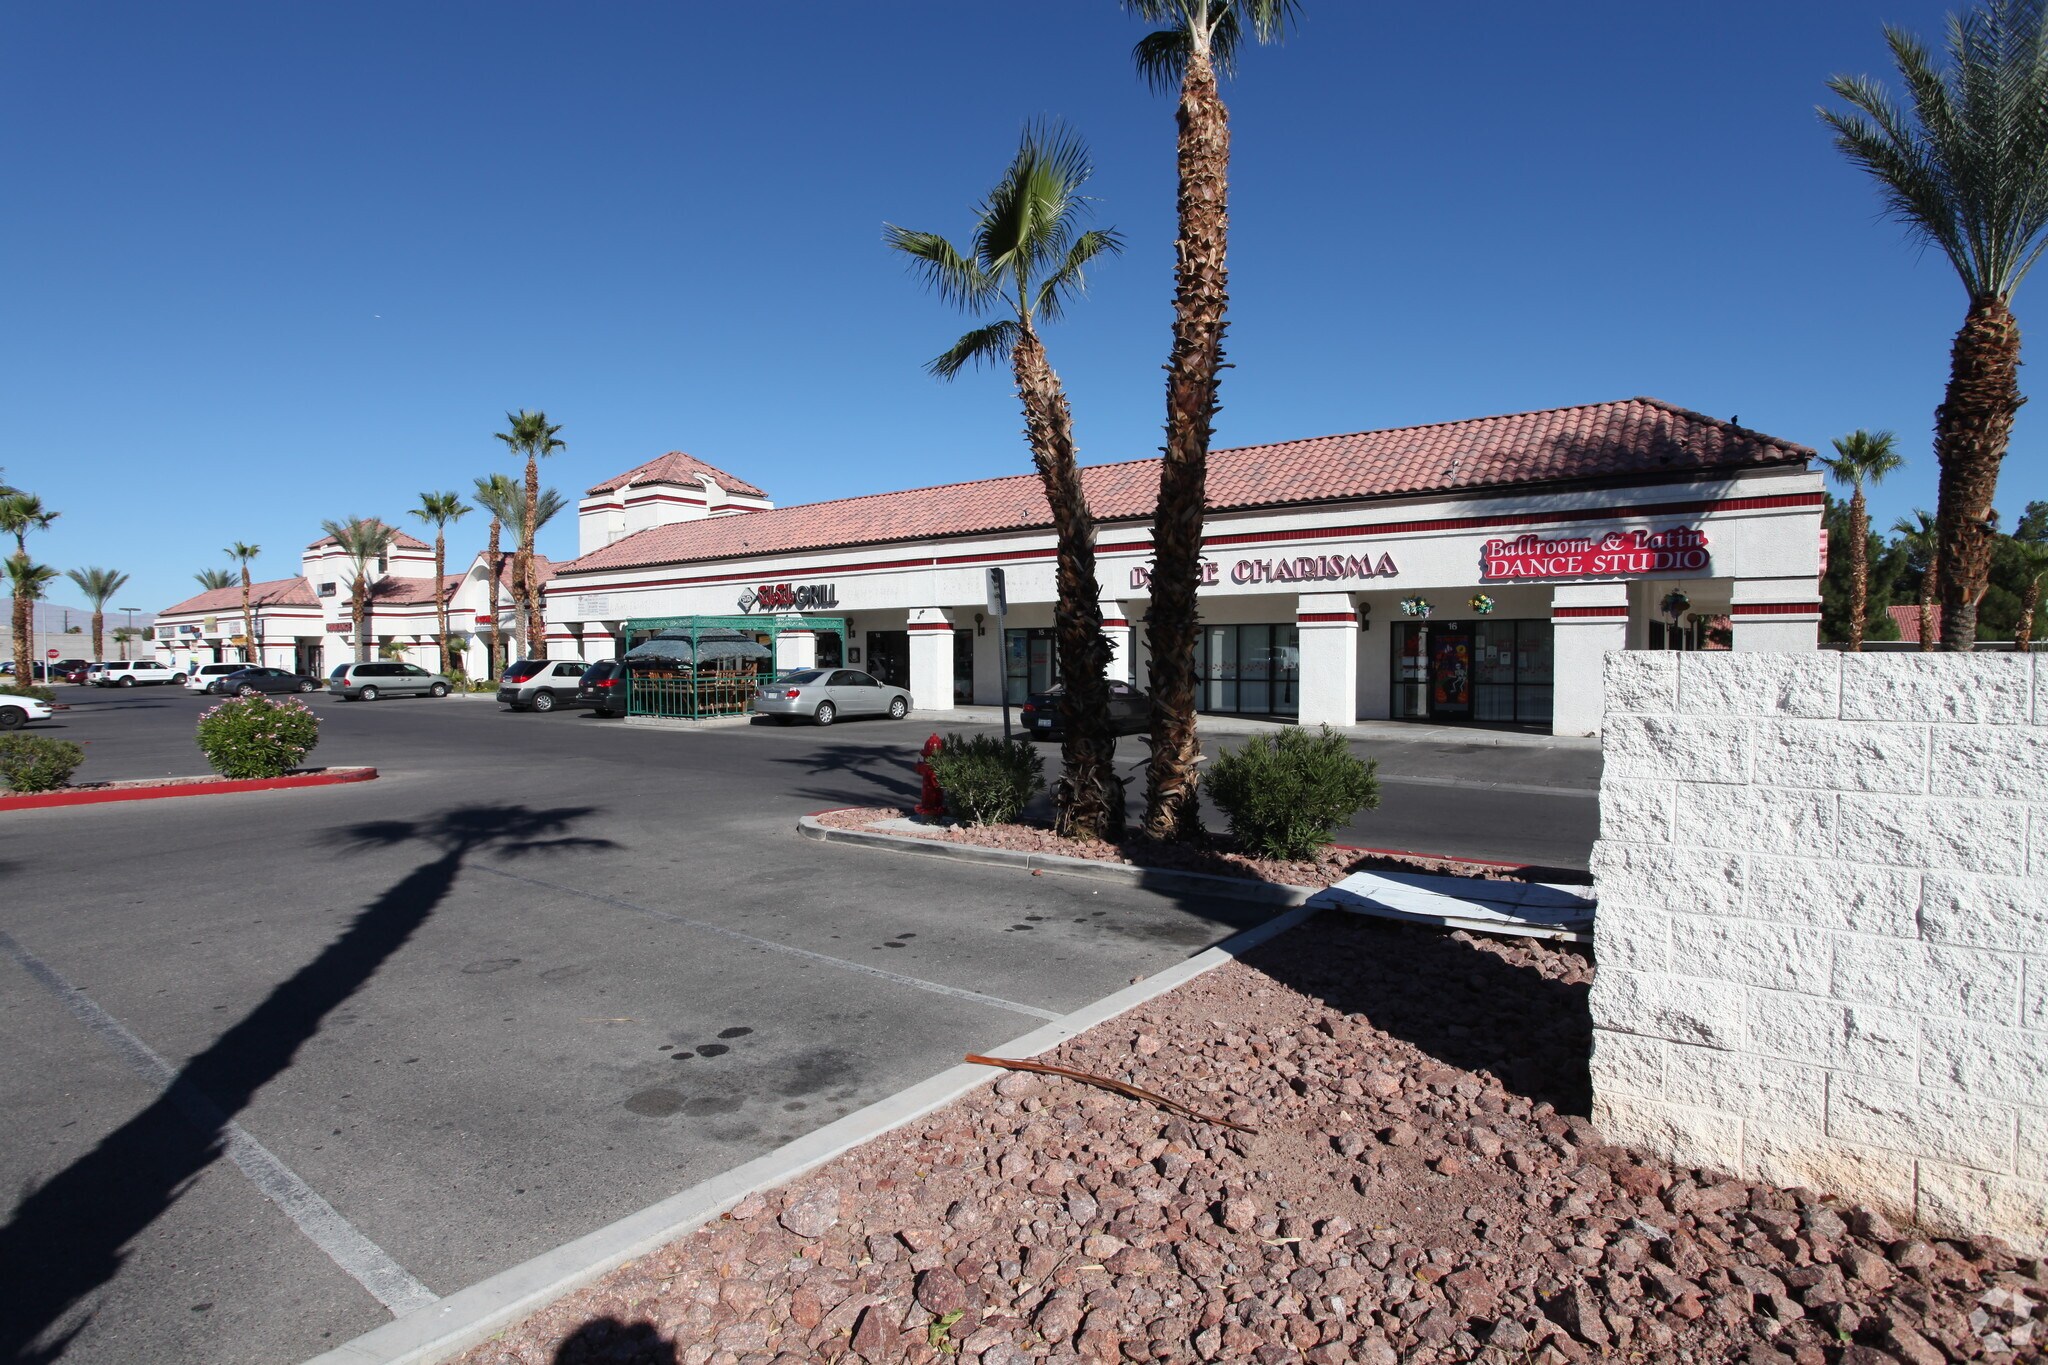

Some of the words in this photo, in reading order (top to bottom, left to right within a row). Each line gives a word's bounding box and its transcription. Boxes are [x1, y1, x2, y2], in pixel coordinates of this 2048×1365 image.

[1489, 537, 1592, 557] Ballroom
[1602, 536, 1625, 552] &
[1633, 530, 1704, 551] Latin
[1232, 551, 1399, 583] CHARISMA
[1488, 556, 1584, 578] DANCE
[1591, 550, 1707, 573] STUDIO
[797, 584, 838, 608] GRILL
[1448, 622, 1458, 631] 16
